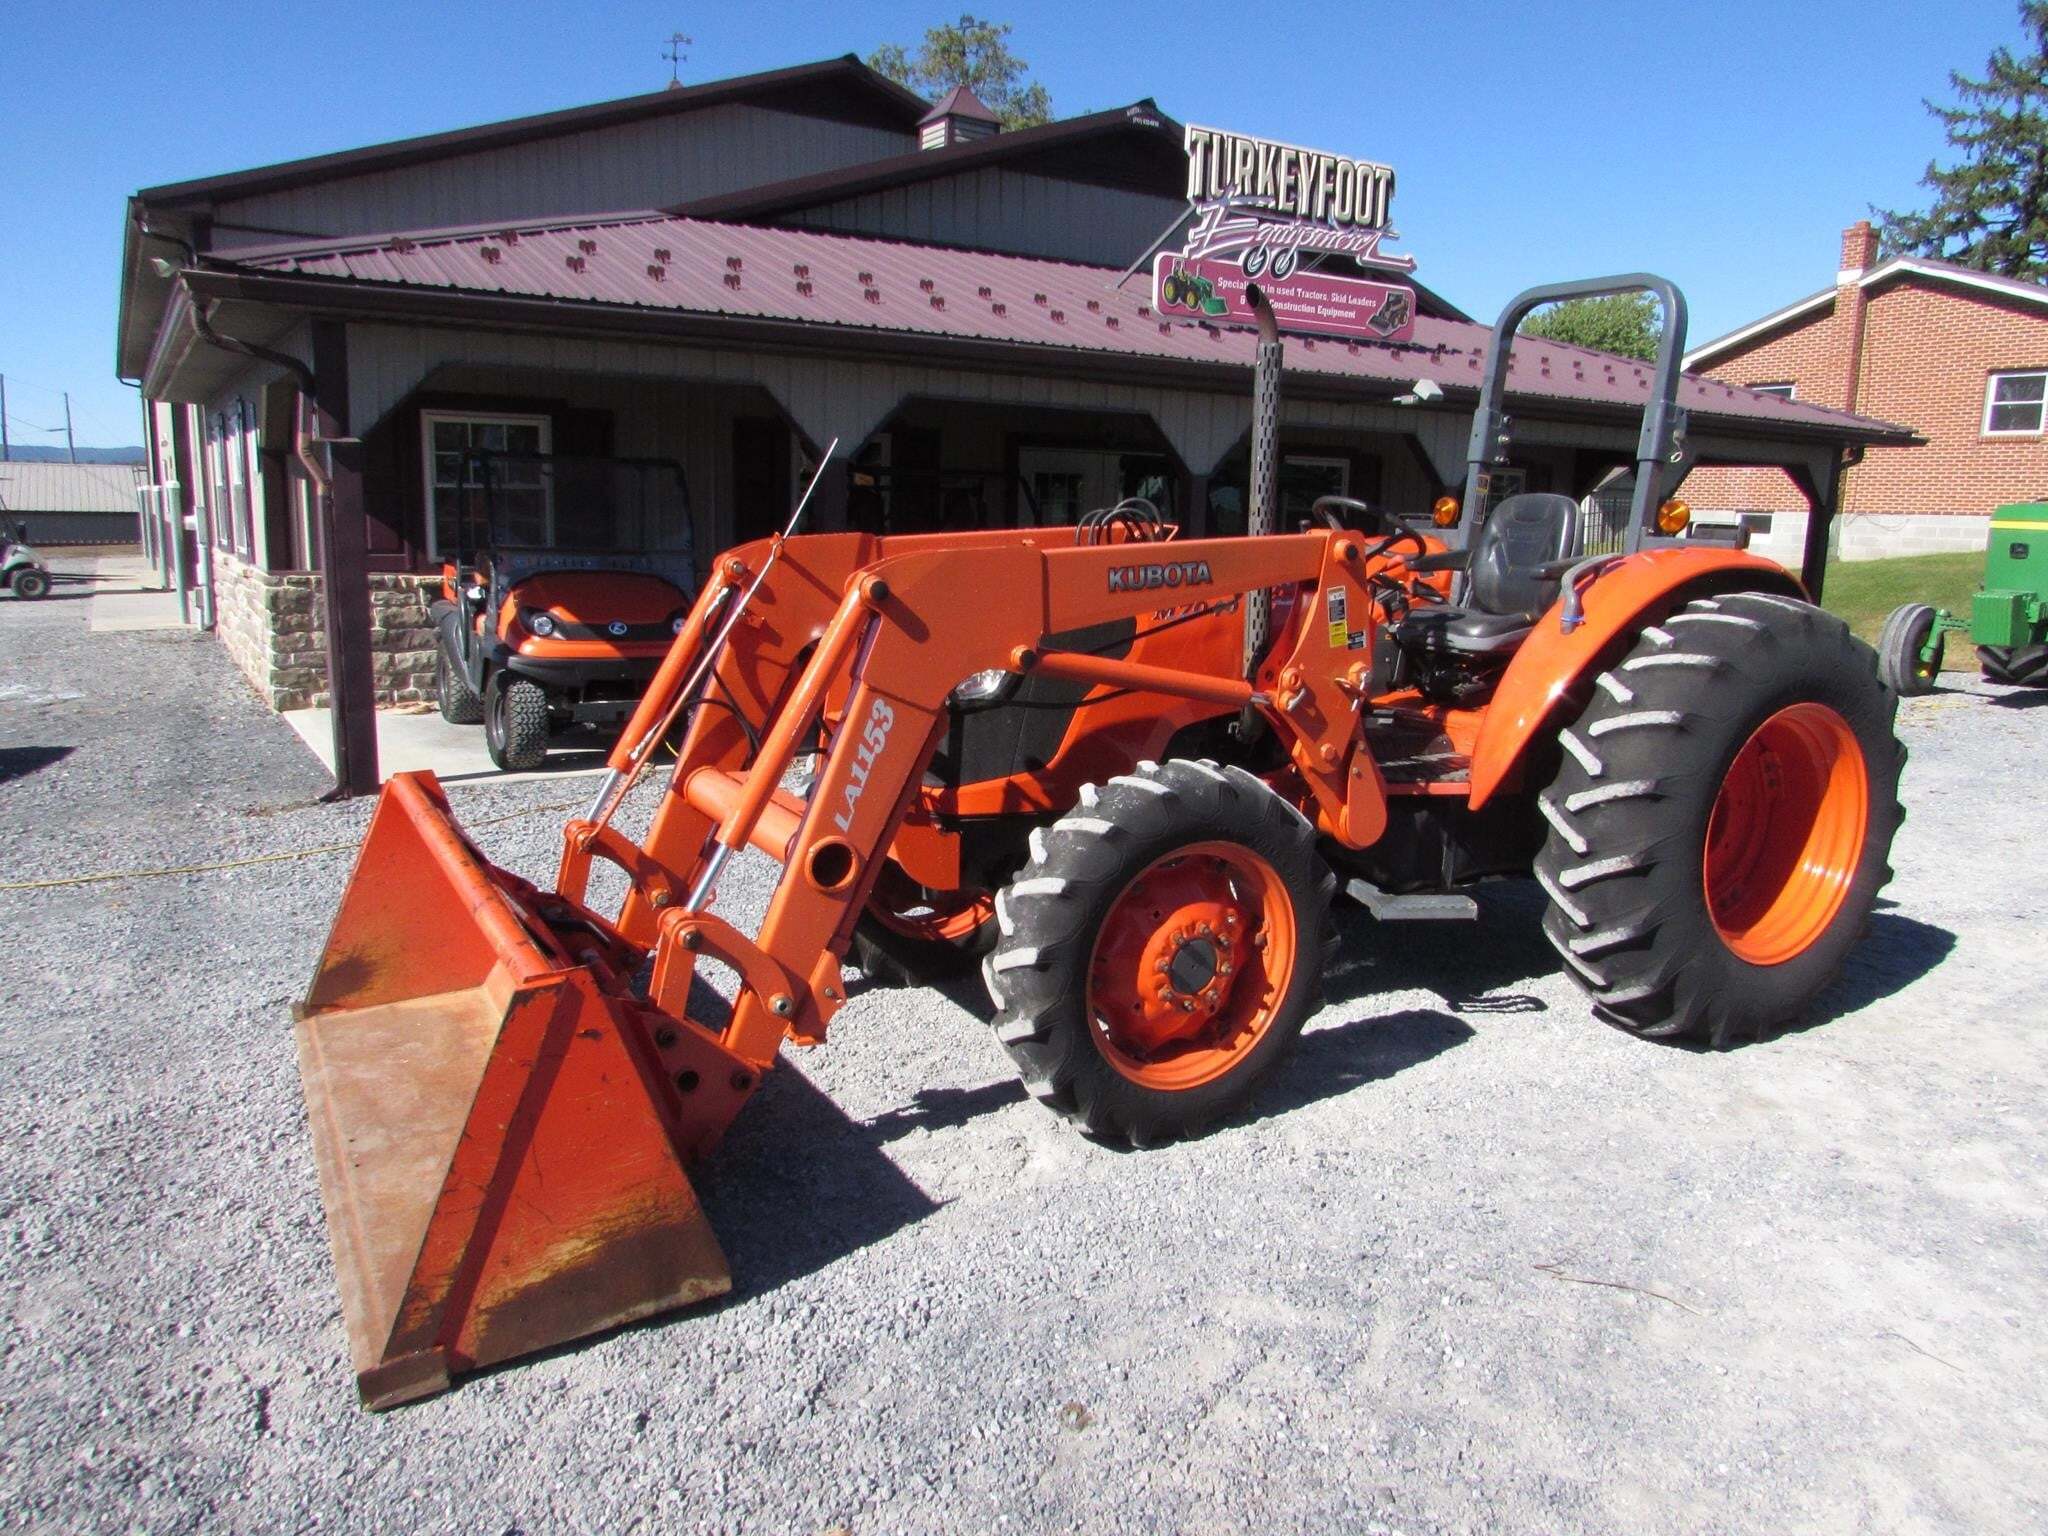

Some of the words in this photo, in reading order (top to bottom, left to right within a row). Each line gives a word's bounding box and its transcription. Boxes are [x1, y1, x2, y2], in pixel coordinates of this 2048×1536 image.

[1188, 127, 1395, 230] TURKEYFOOT
[1187, 201, 1415, 266] Equipment
[1267, 283, 1275, 295] in
[1276, 286, 1295, 297] used
[1331, 292, 1347, 304] Skid
[1348, 294, 1377, 308] Loaders
[1269, 298, 1316, 314] Construction
[1317, 304, 1356, 319] Equipment
[1108, 560, 1213, 593] KUBOTA
[834, 698, 894, 833] LA1153
